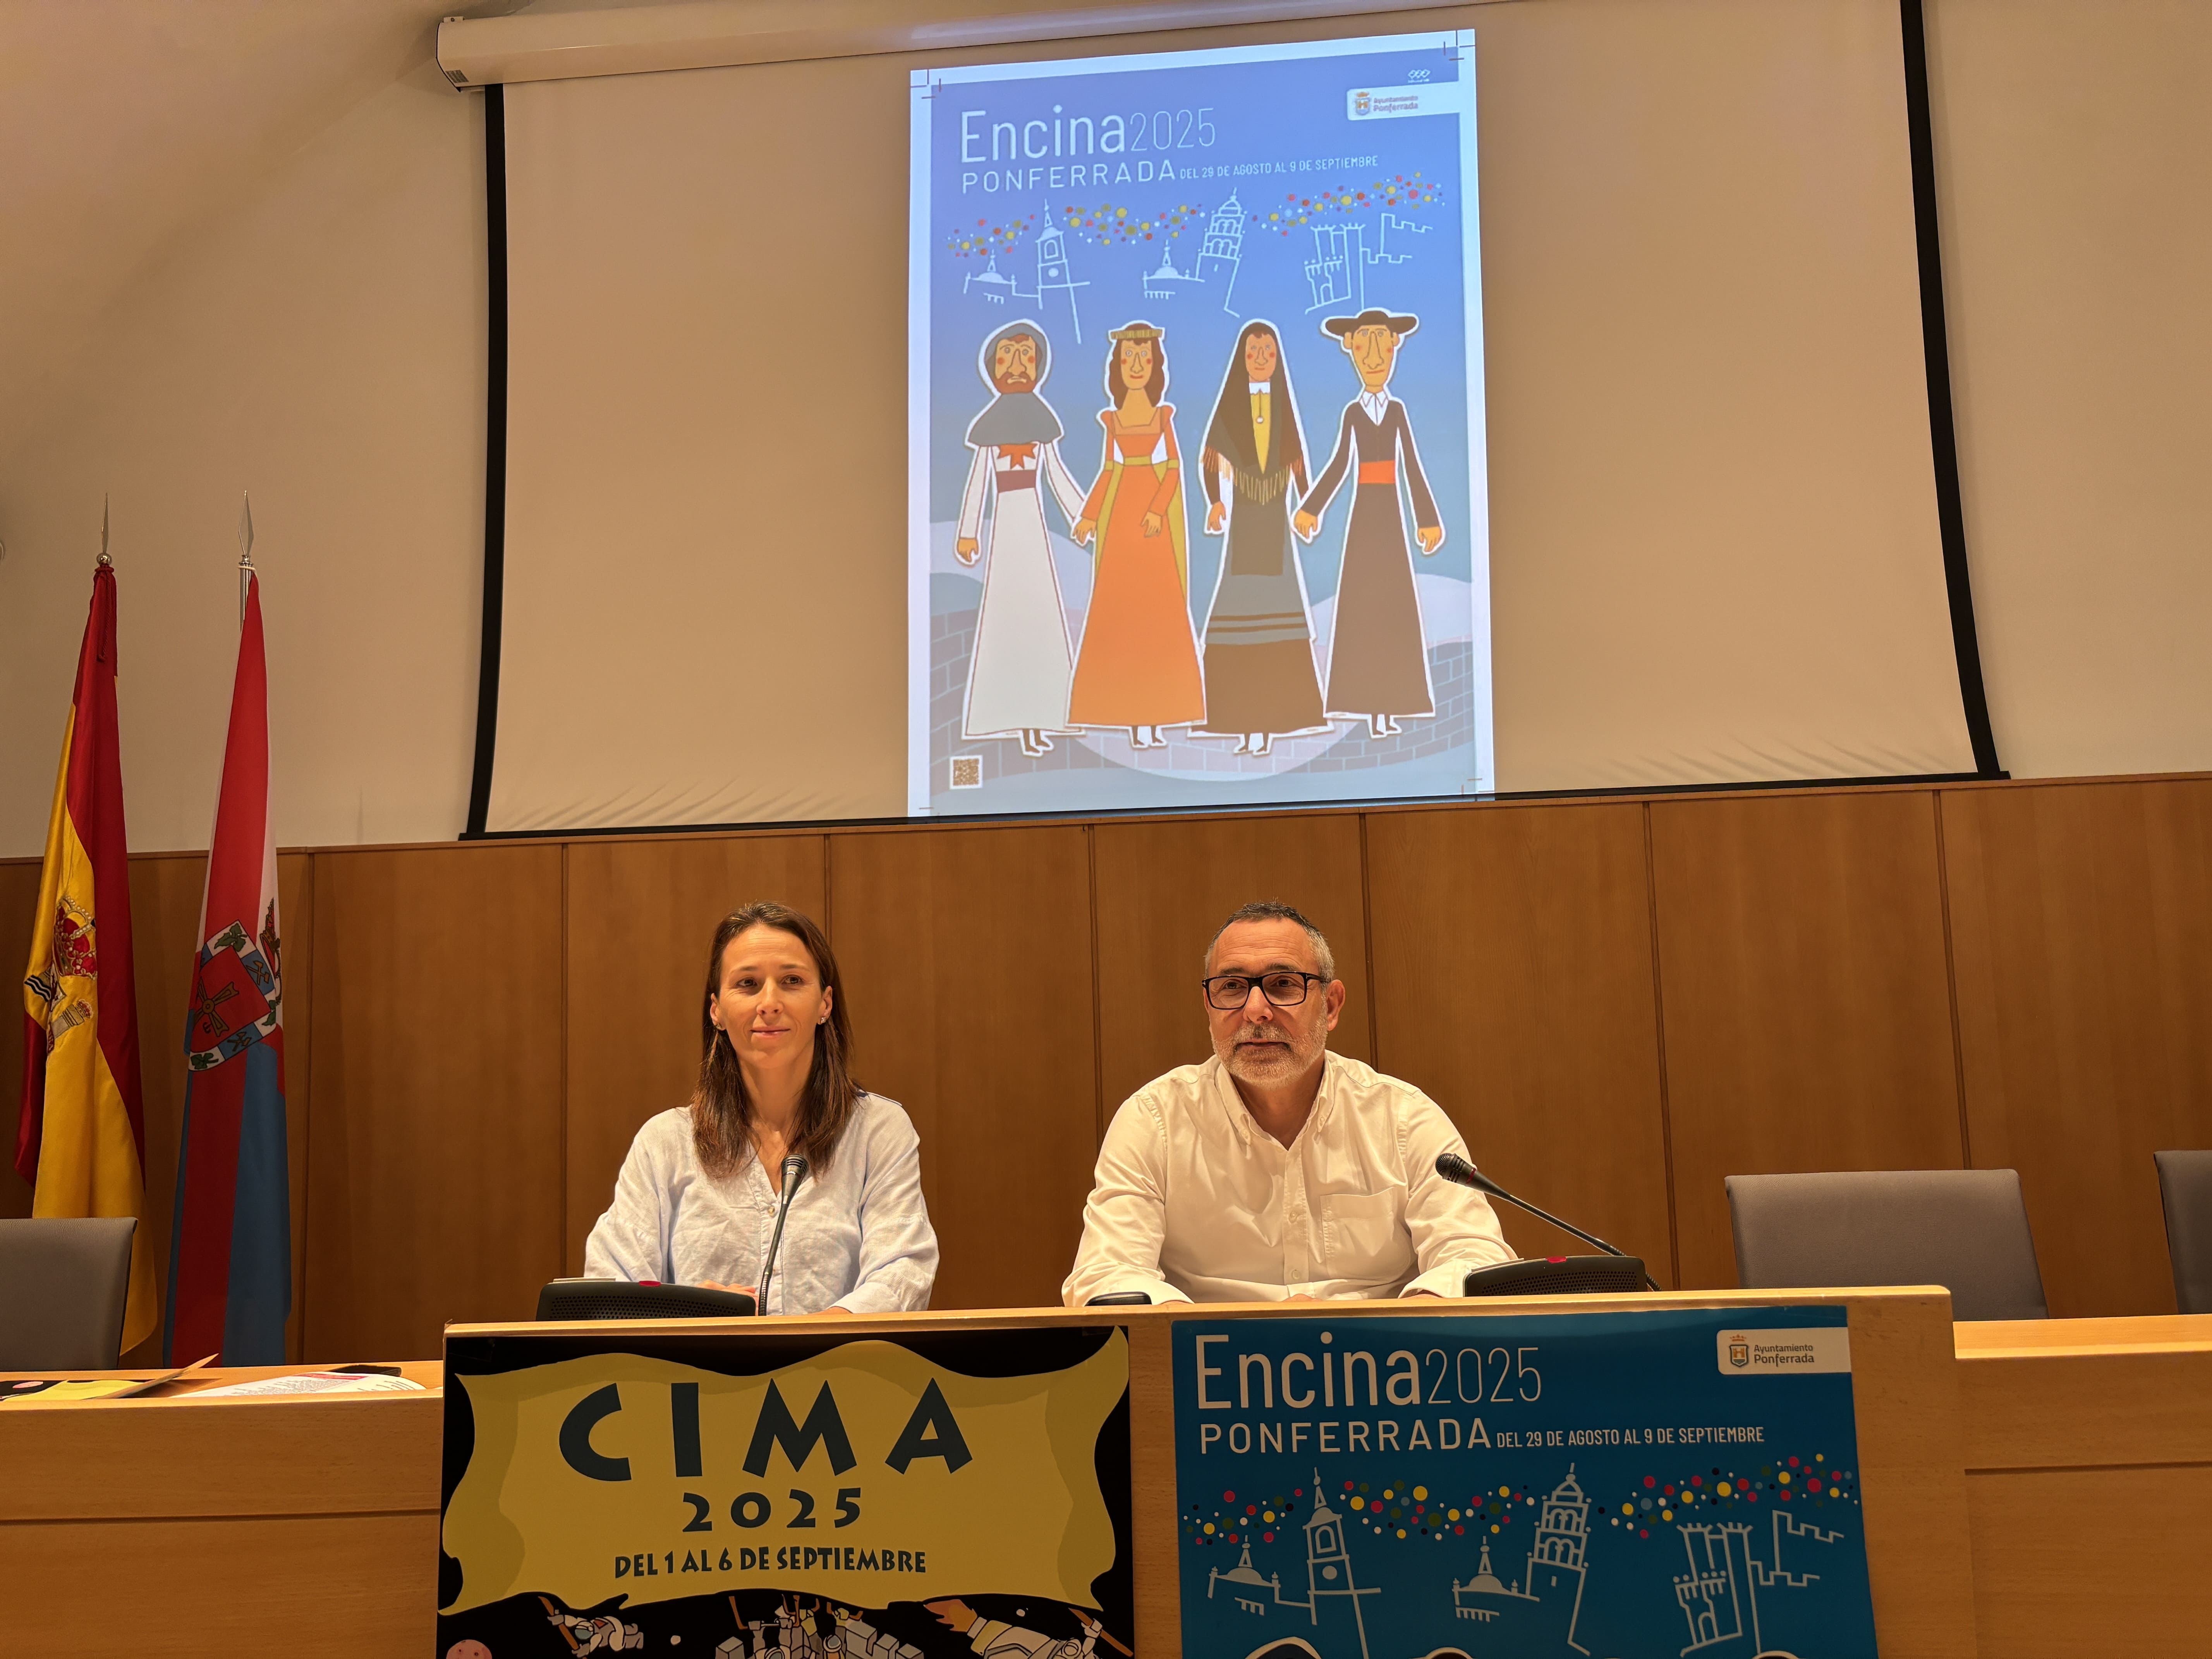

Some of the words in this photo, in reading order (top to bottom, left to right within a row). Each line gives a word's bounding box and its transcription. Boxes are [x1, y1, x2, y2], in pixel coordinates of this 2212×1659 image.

[1373, 102, 1419, 112] Ponferrada
[1374, 96, 1419, 104] Ayuntamiento
[962, 105, 1125, 163] Encina
[1130, 107, 1216, 151] 2025
[963, 160, 1175, 194] PONFERRADA
[1180, 168, 1199, 180] DEL
[1202, 166, 1214, 178] 29
[1217, 165, 1230, 177] DE
[1233, 162, 1272, 176] AGOSTO
[1274, 161, 1287, 173] AL
[1290, 161, 1296, 172] 9
[1298, 160, 1312, 171] DE
[1316, 155, 1379, 170] SEPTIEMBRE
[1753, 1344, 1814, 1354] Ayuntamiento
[1753, 1353, 1815, 1367] Ponferrada
[1196, 1331, 1420, 1409] Encina
[1425, 1347, 1542, 1405] 2025
[559, 1377, 973, 1482] CIMA
[1200, 1417, 1492, 1454] PONFERRADA
[1497, 1432, 1523, 1448] DEL
[1526, 1431, 1542, 1447] 29
[1547, 1431, 1565, 1446] DE
[1568, 1429, 1619, 1446] AGOSTO
[1624, 1429, 1641, 1444] AL
[1644, 1428, 1652, 1444] 9
[1657, 1428, 1675, 1443] DE
[1679, 1426, 1765, 1443] SEPTIEMBRE
[682, 1487, 861, 1532] 2025
[615, 1553, 658, 1578] DEL
[664, 1550, 674, 1574] 1
[681, 1549, 712, 1573] AL
[718, 1547, 733, 1571] 6
[740, 1546, 770, 1570] DE
[777, 1546, 926, 1573] SEPTIEMBRE
